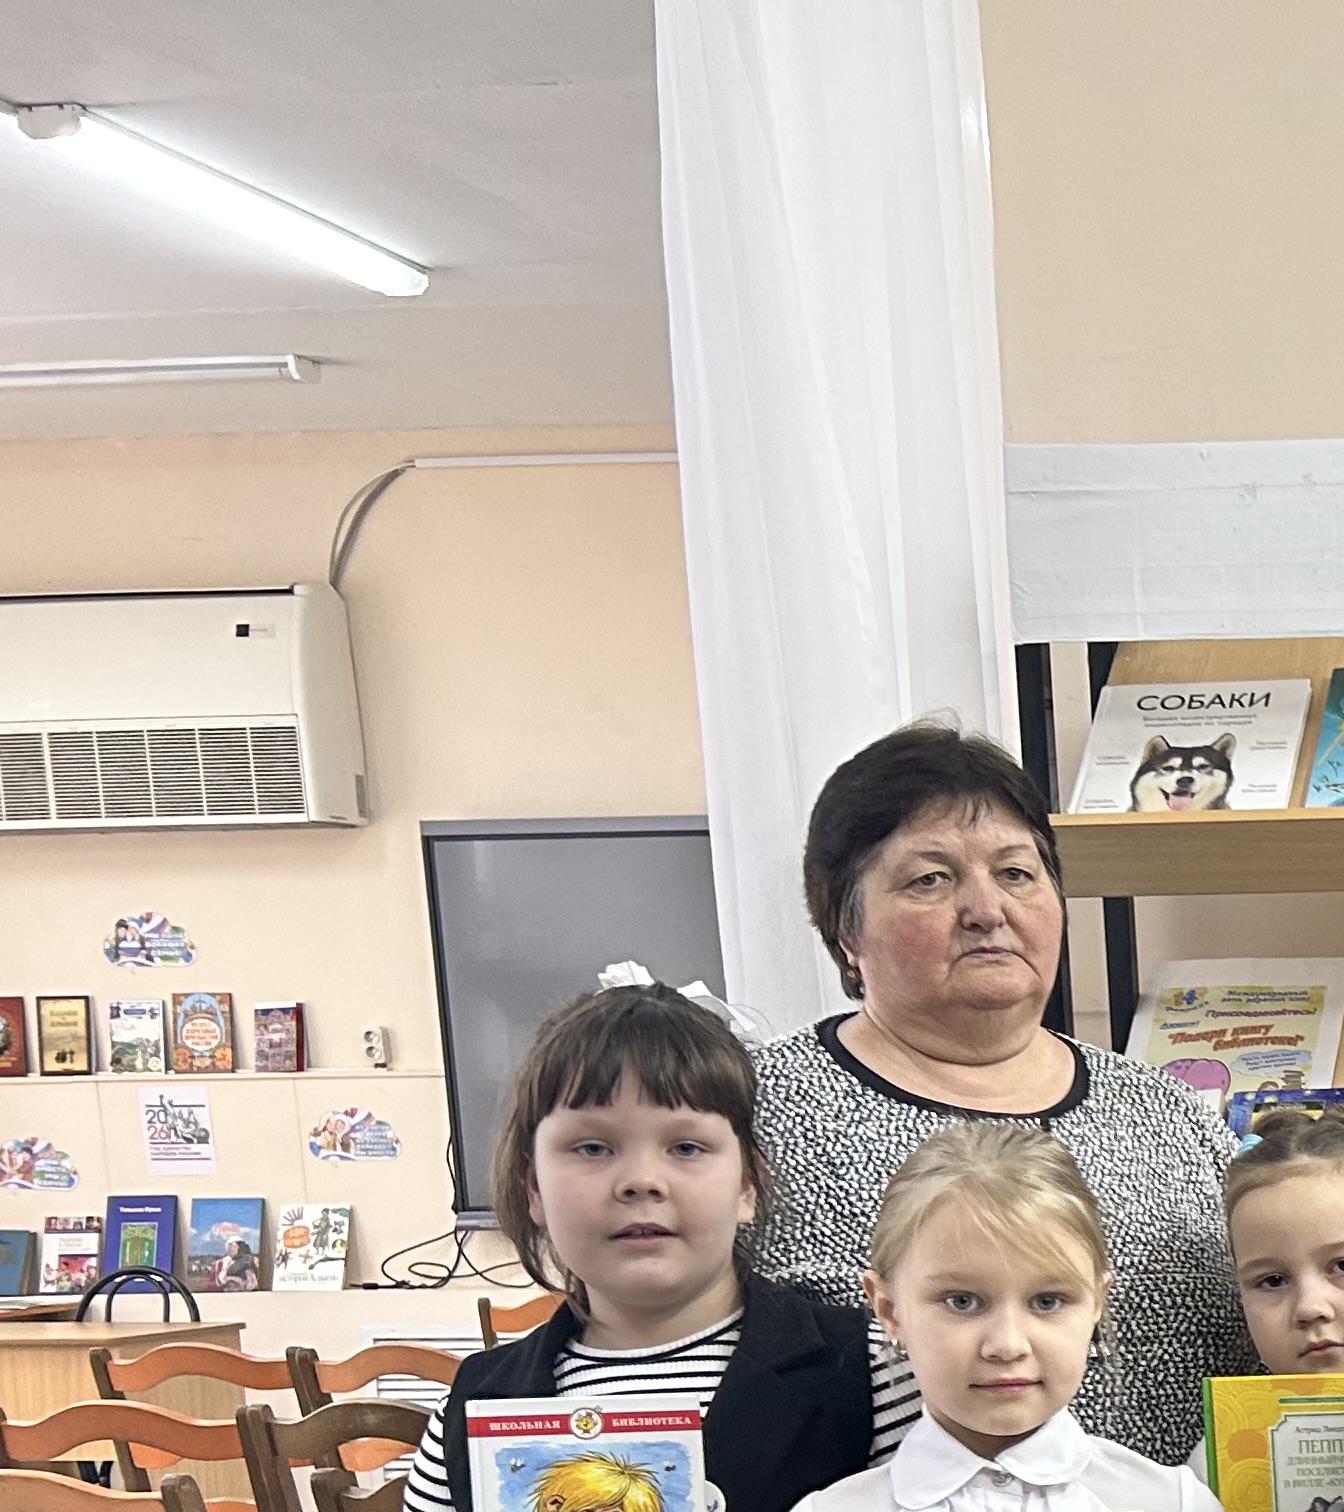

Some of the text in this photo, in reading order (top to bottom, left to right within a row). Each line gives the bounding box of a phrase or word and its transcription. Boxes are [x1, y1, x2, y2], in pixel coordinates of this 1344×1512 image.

[1136, 692, 1271, 711] СОБАКИ
[145, 1109, 168, 1124] 20
[147, 1125, 169, 1140] 26
[489, 1416, 692, 1432] ШКОЛЬНАЯ БИБЛИОТЕКА
